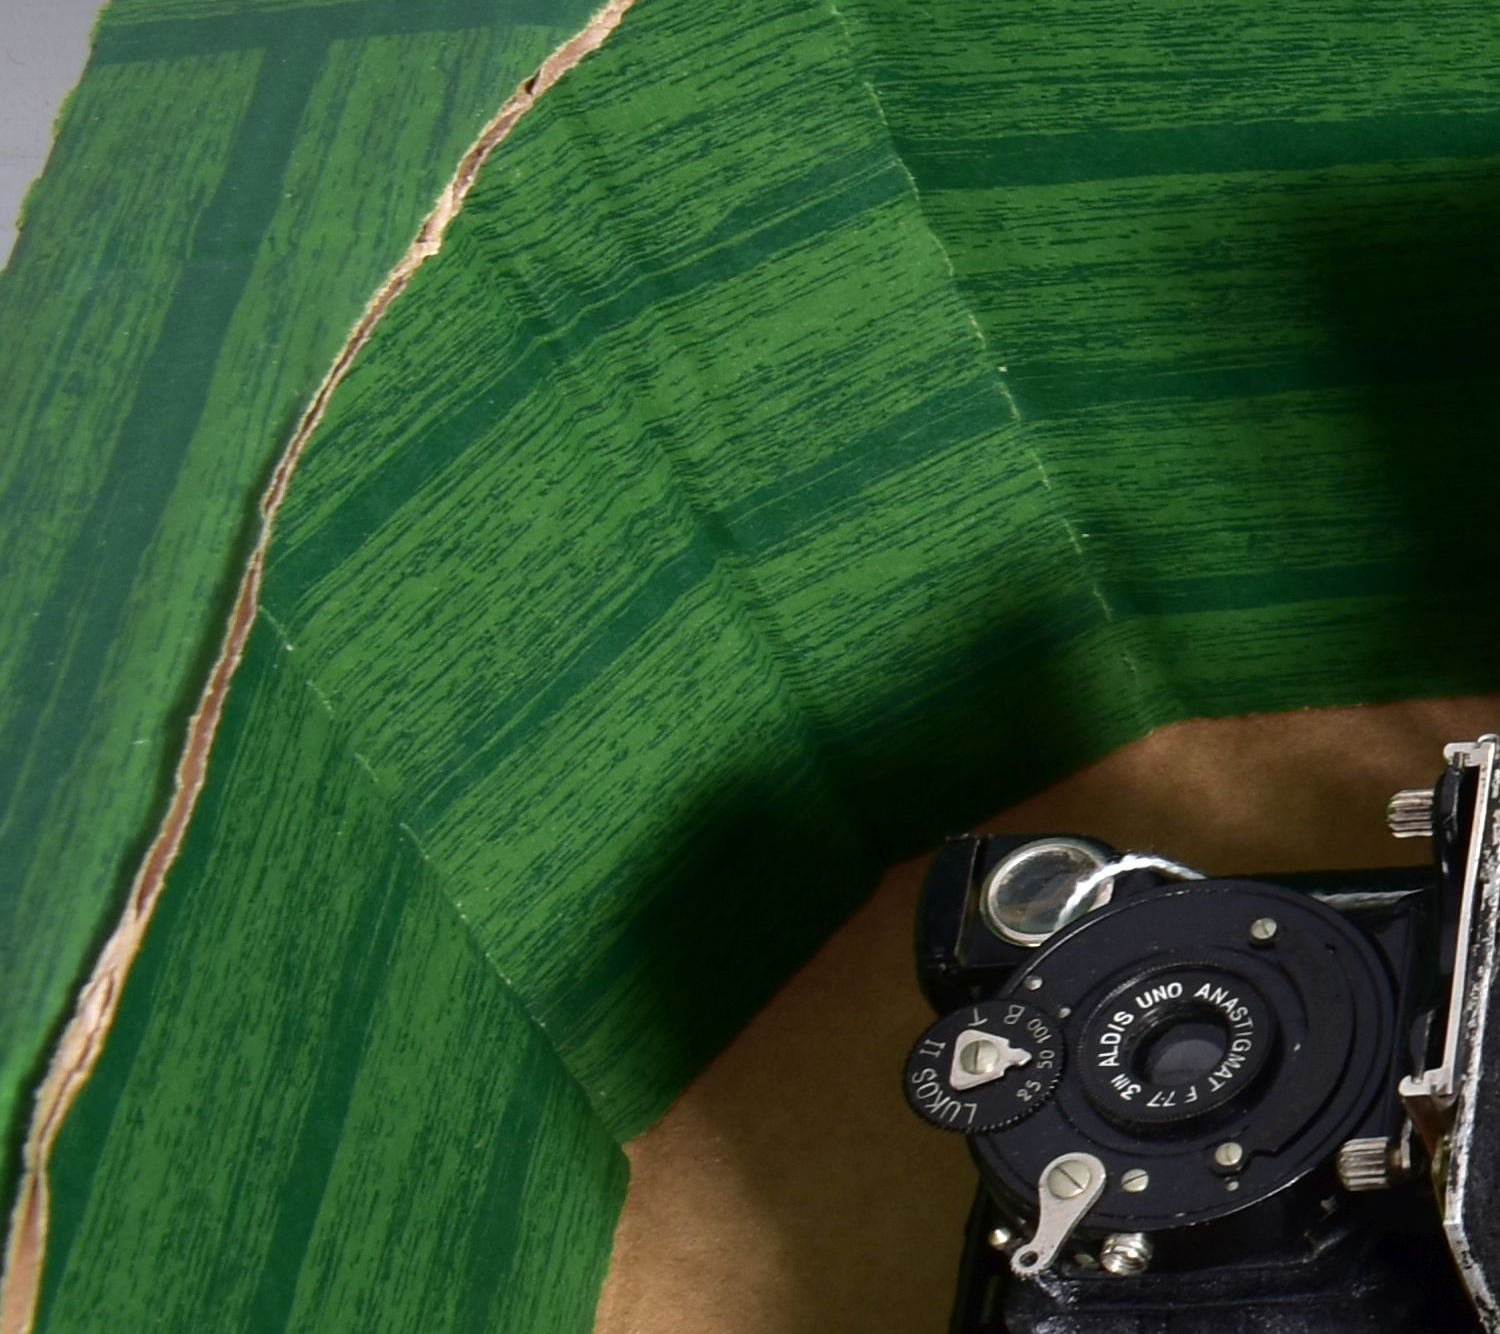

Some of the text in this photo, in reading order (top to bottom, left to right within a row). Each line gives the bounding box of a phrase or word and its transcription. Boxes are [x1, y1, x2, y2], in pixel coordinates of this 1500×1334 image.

[1135, 981, 1184, 1009] UNO
[1004, 1004, 1026, 1026] B
[1027, 1018, 1053, 1045] 100
[1097, 1010, 1135, 1067] ALDIS
[1193, 982, 1254, 1092] ANASTIGMAT
[1036, 1049, 1056, 1069] 50
[911, 1067, 978, 1124] LUKOS
[1016, 1079, 1042, 1102] 25
[1184, 1085, 1198, 1103] F
